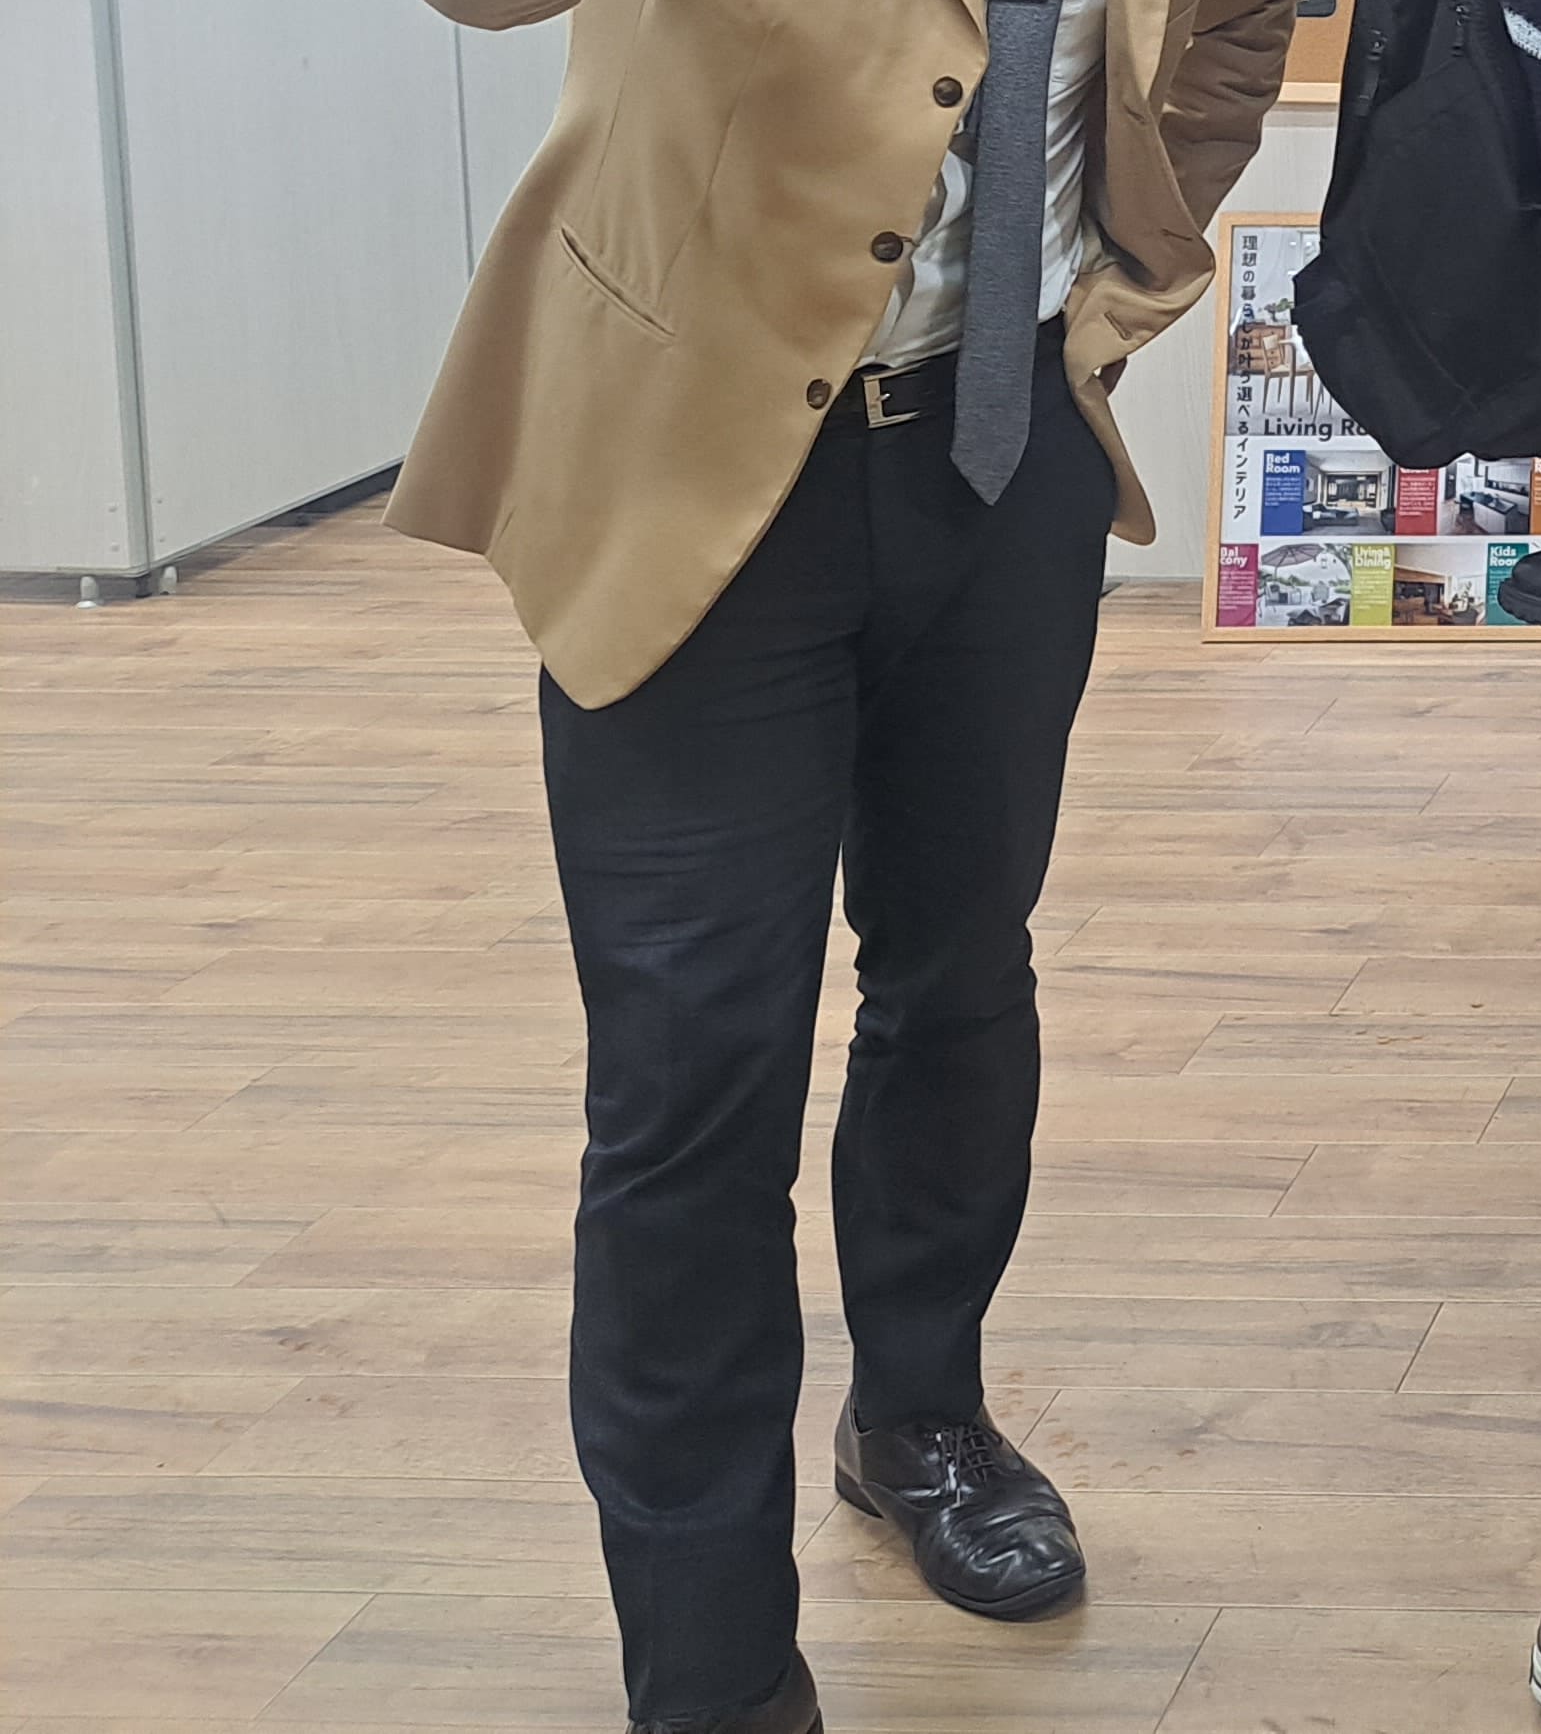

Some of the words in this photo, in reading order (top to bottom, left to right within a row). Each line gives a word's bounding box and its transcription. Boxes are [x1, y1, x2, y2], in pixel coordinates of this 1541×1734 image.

[1263, 418, 1333, 442] Living
[1340, 419, 1369, 436] Ro
[1266, 453, 1290, 464] Bed
[1265, 463, 1301, 474] Room
[1489, 546, 1517, 557] Kids
